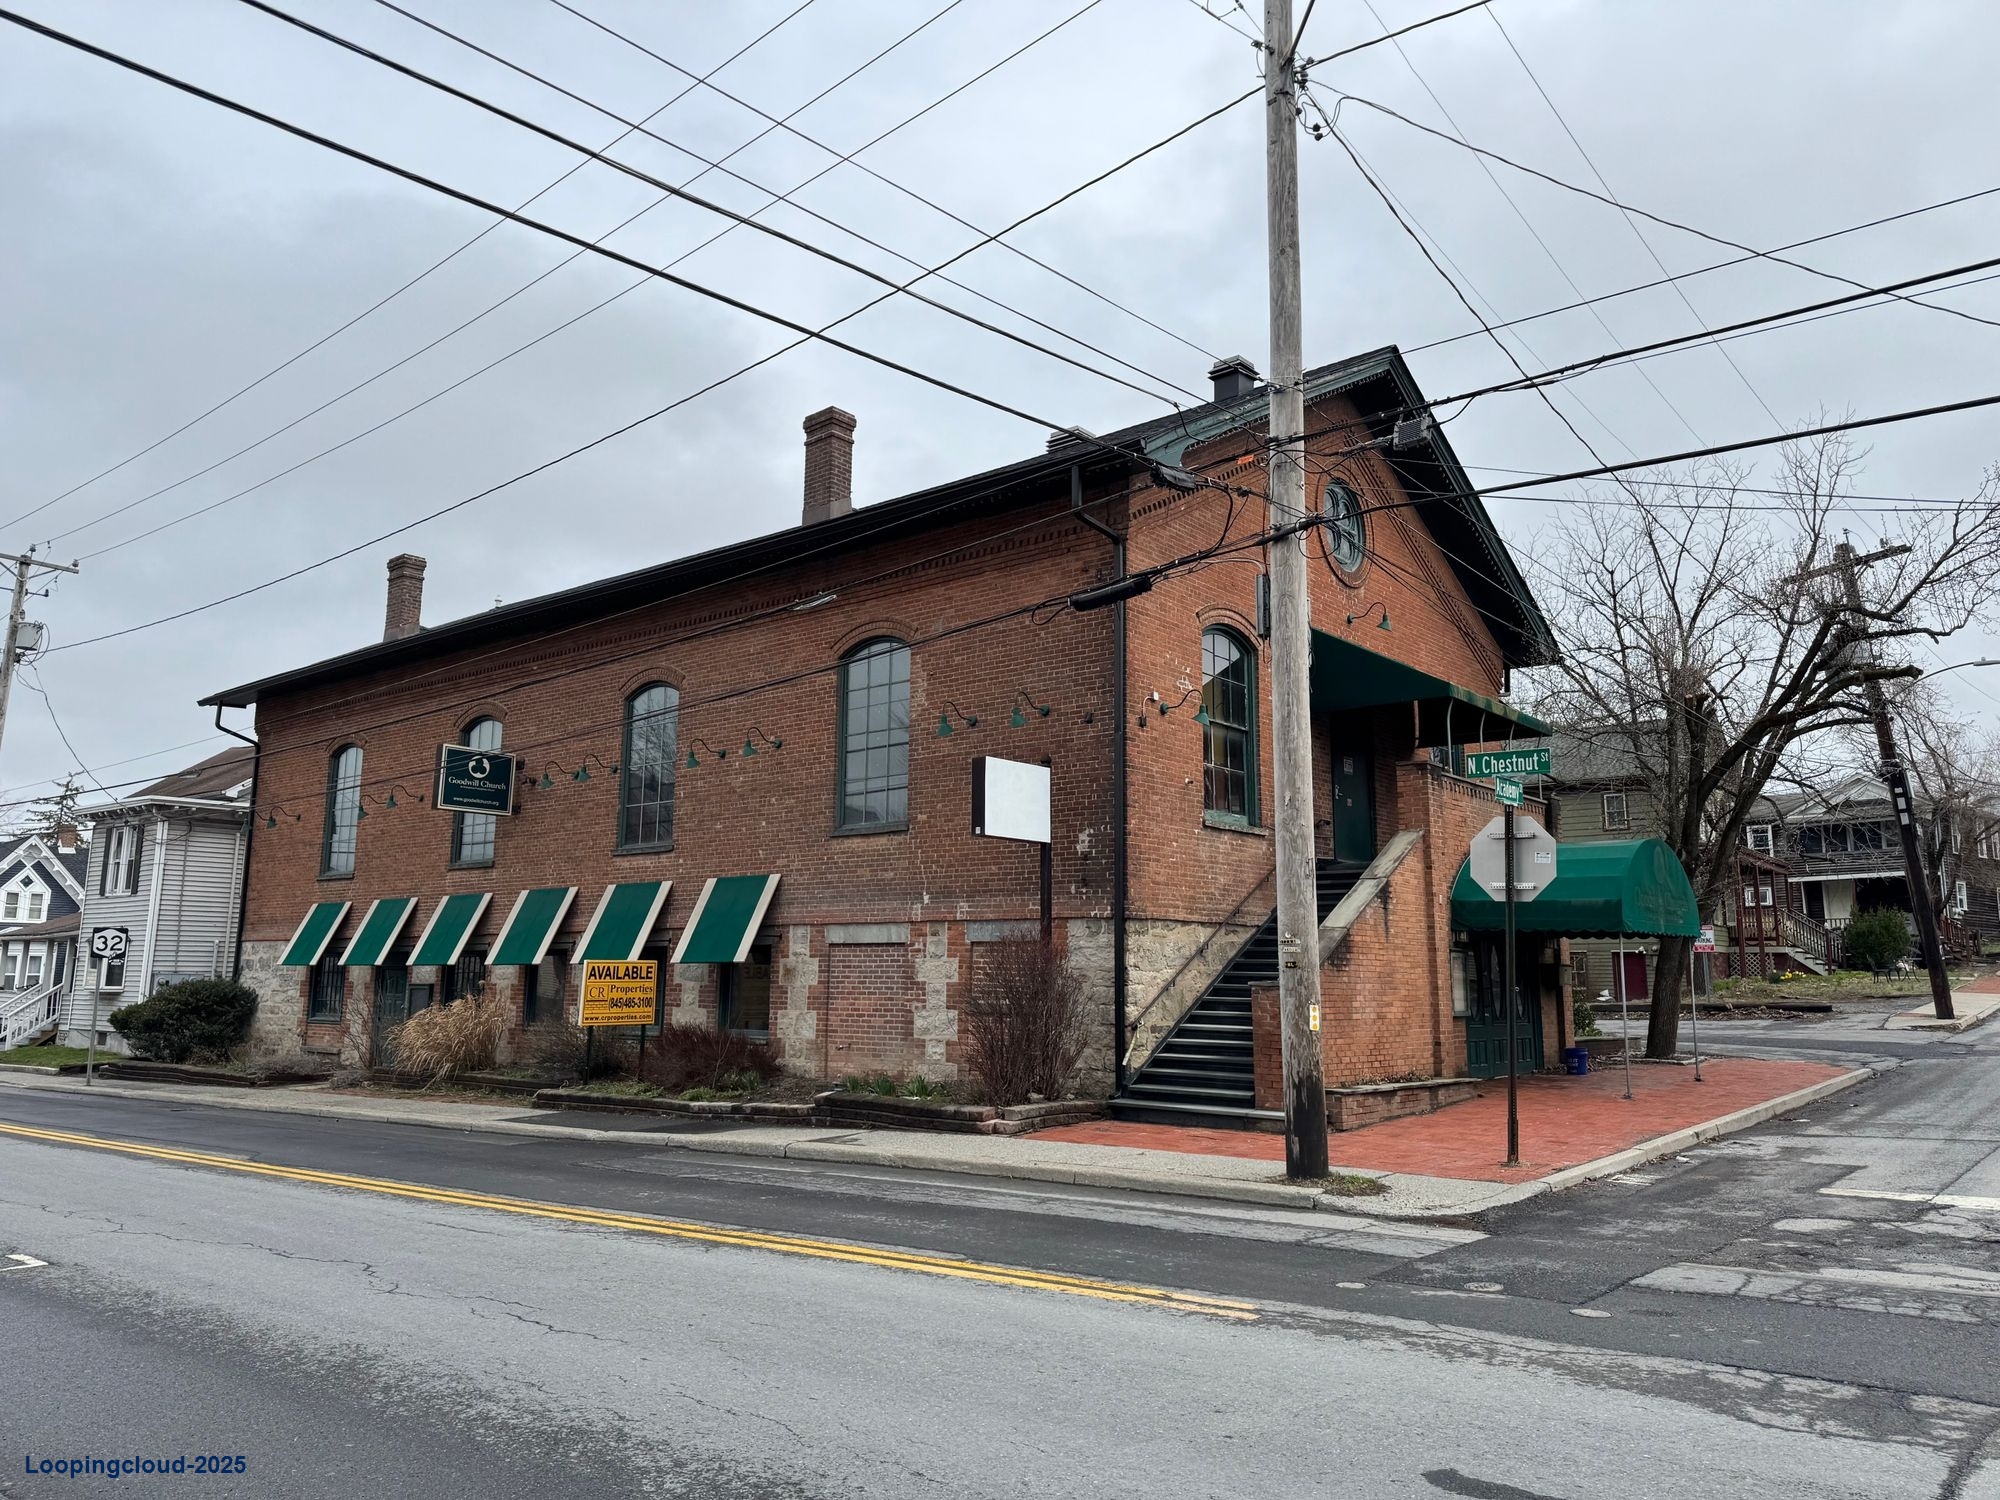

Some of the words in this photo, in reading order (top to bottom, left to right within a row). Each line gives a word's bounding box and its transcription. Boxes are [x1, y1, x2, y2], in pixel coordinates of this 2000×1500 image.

[1467, 757, 1480, 775] N.
[1482, 752, 1539, 774] Chestnut
[1541, 751, 1549, 762] St
[448, 776, 480, 787] Goodwill
[480, 780, 506, 790] Church
[1496, 778, 1519, 803] Academy
[96, 935, 123, 951] 32
[588, 965, 653, 980] AVAILABLE
[589, 986, 605, 998] CR
[610, 984, 653, 995] Properties
[609, 996, 652, 1011] (845)485-3100
